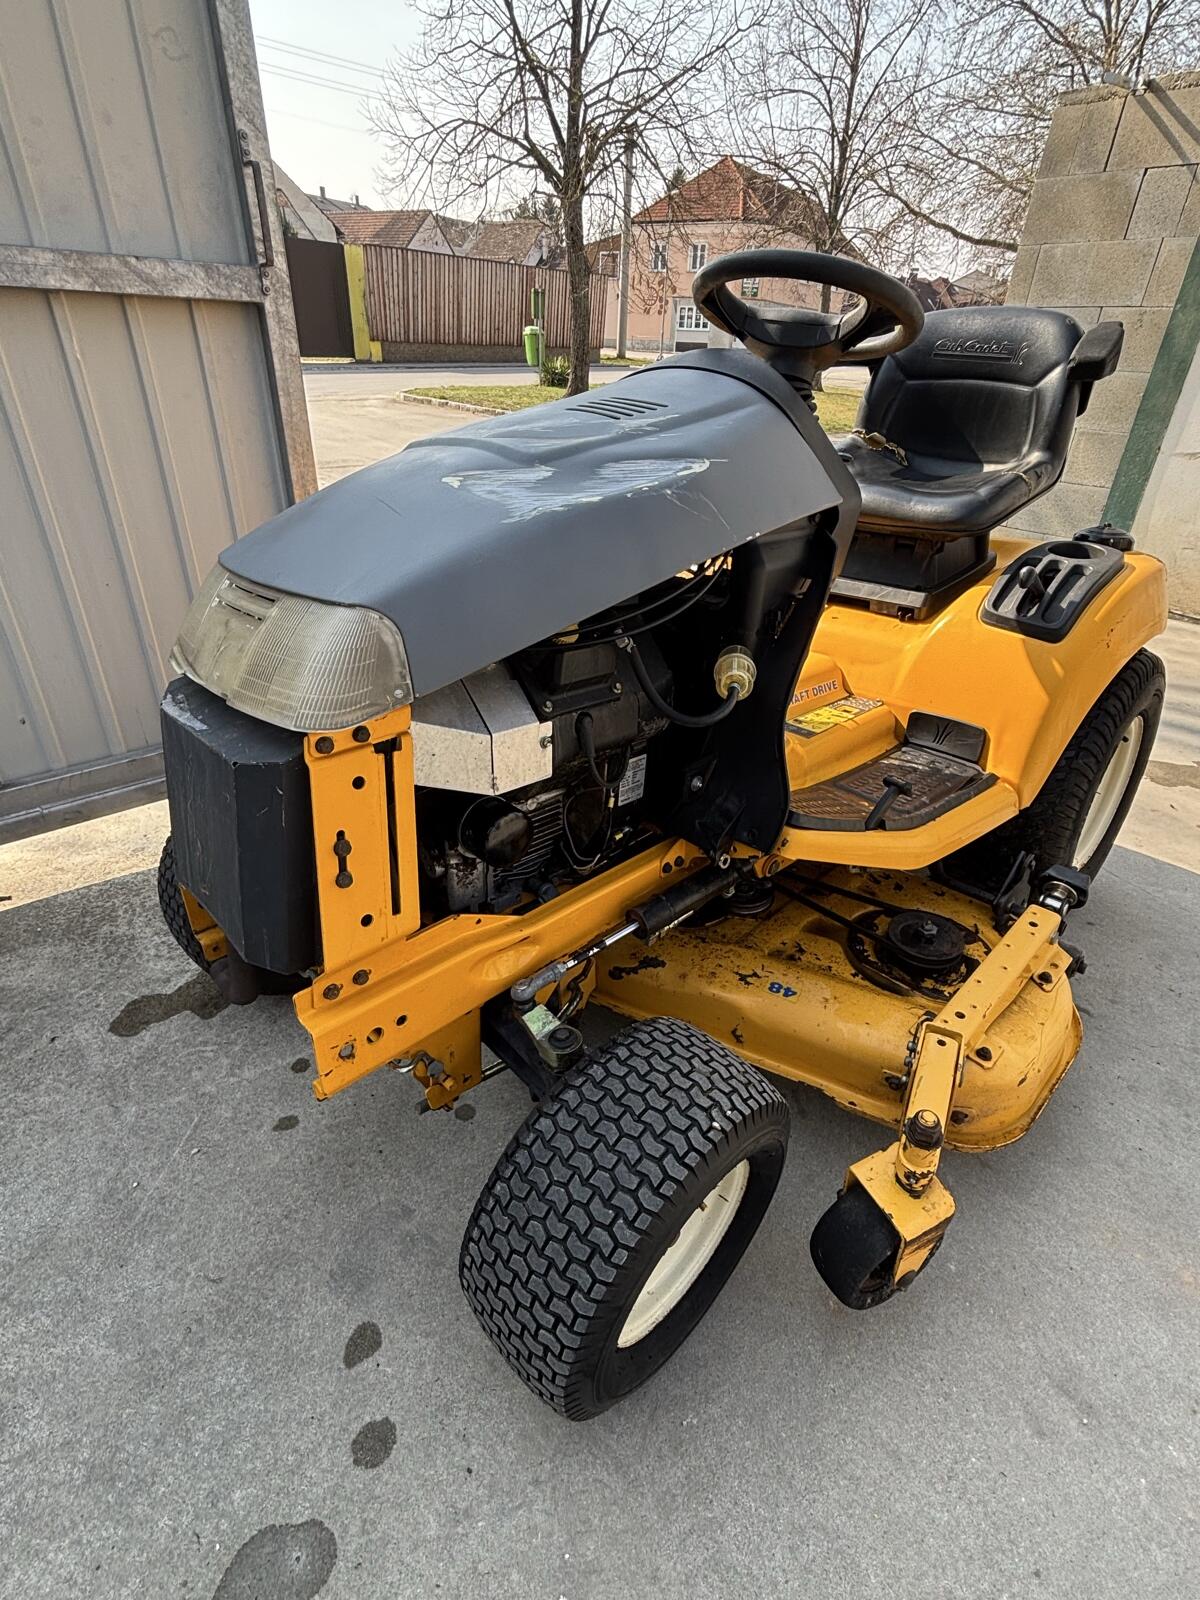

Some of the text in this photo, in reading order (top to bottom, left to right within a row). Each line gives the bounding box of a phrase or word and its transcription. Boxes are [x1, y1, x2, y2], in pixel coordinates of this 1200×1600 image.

[963, 339, 1014, 354] Cadet
[812, 680, 838, 697] DRIVE
[768, 981, 798, 998] 48
